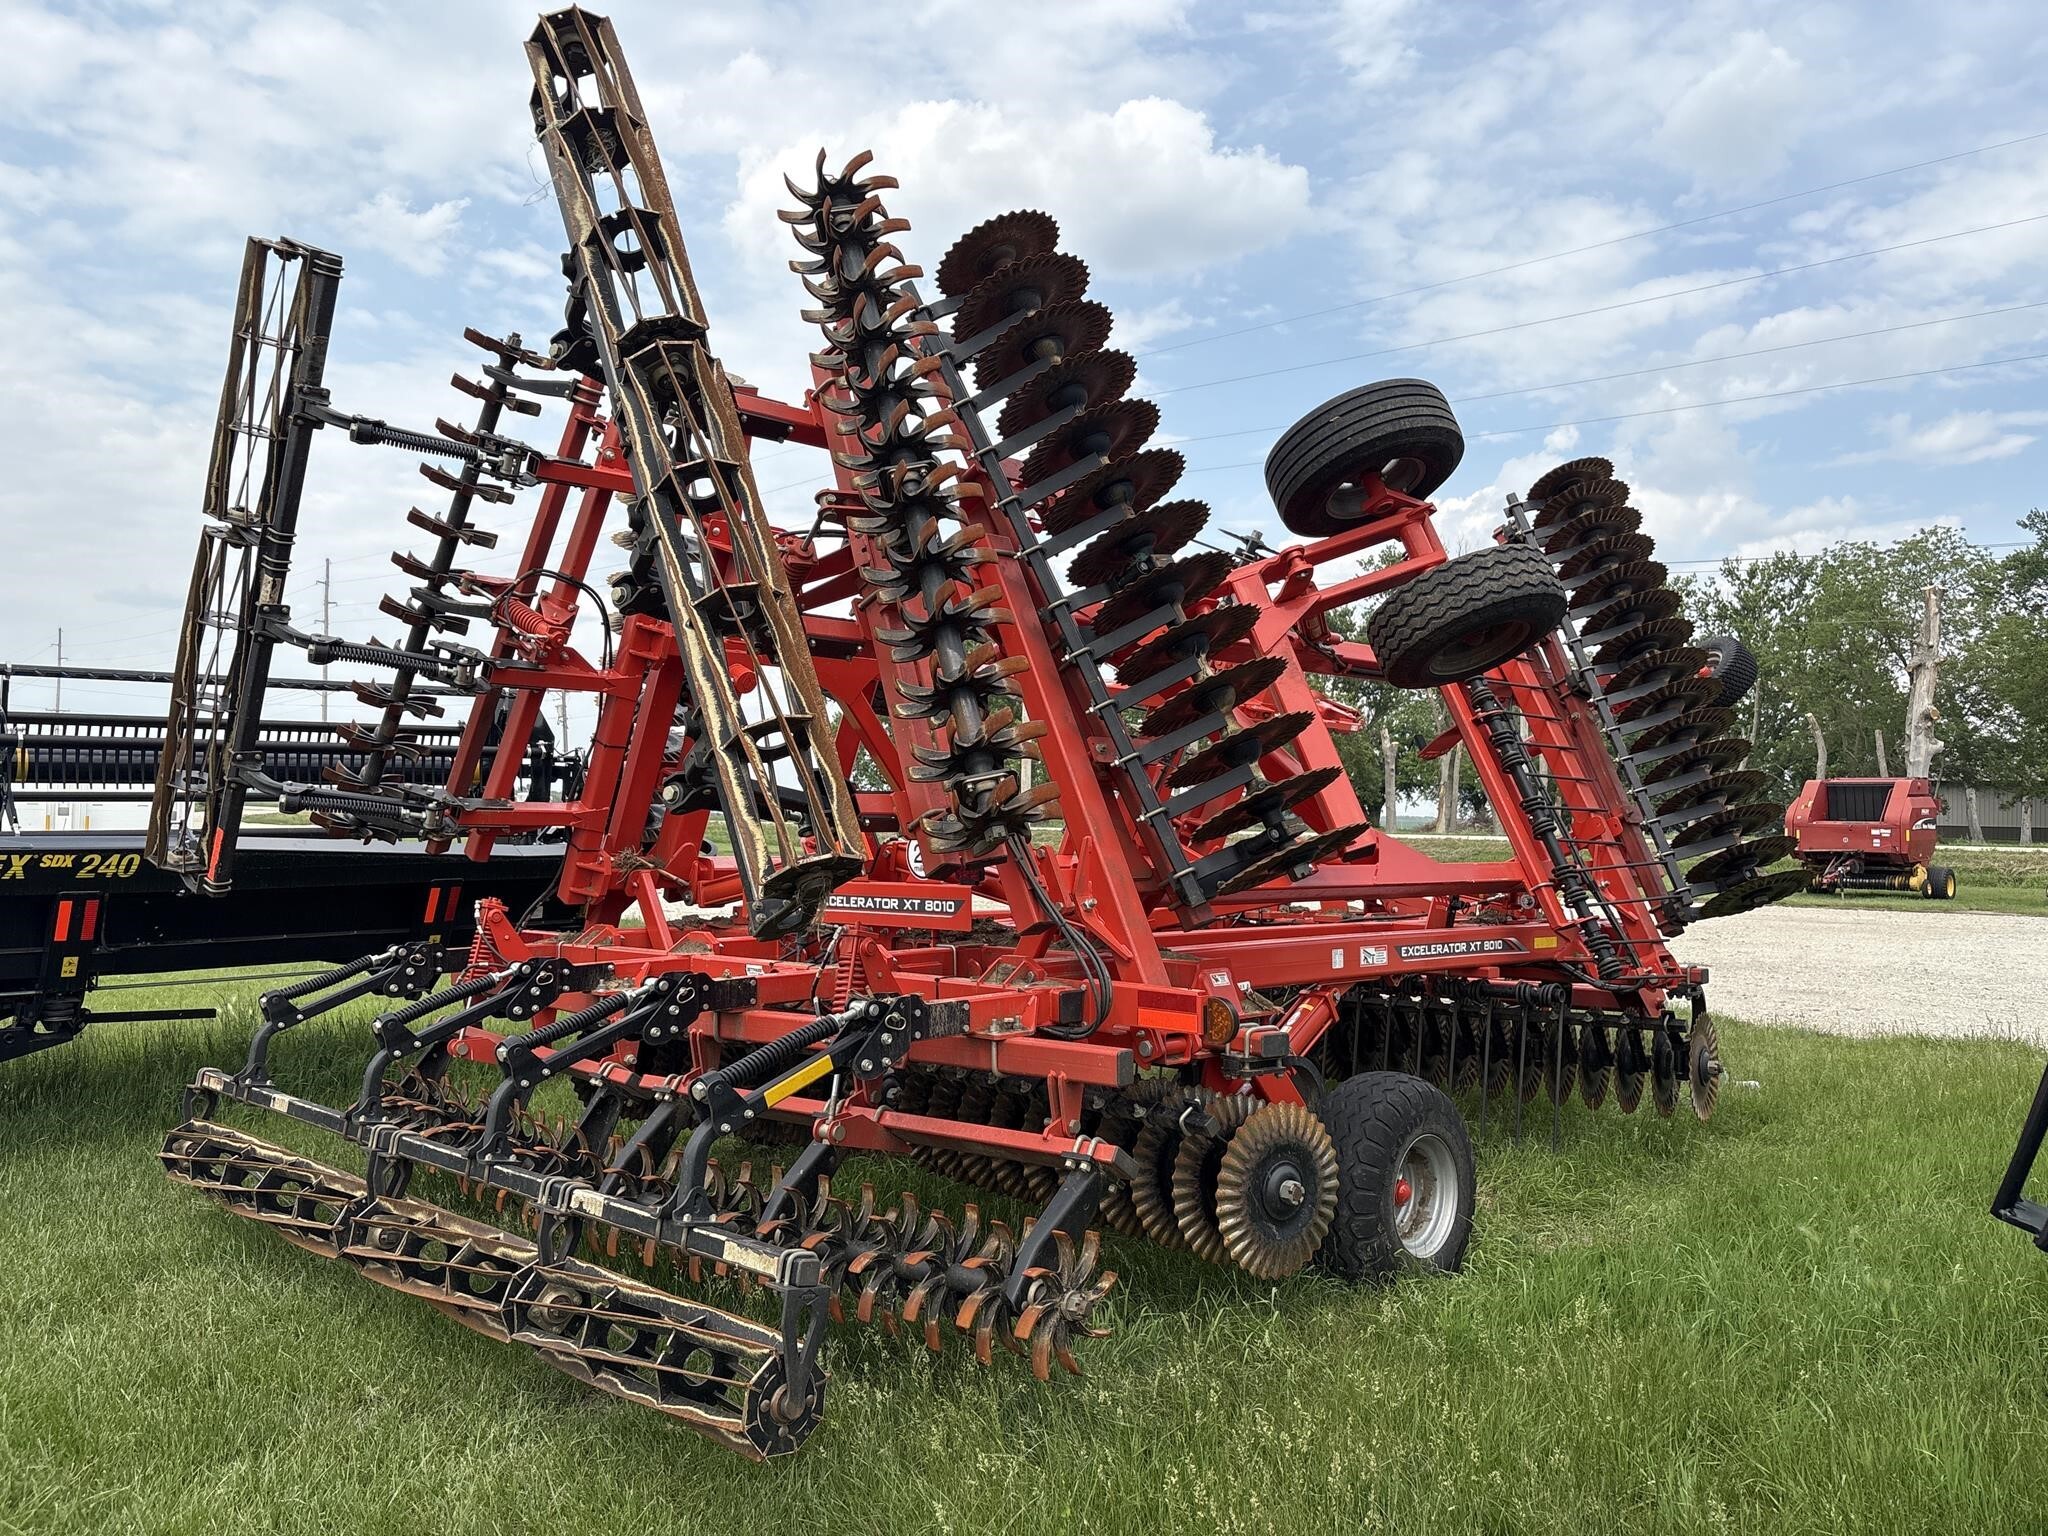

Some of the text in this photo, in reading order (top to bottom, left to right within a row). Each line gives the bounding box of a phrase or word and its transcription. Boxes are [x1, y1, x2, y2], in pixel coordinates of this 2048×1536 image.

[39, 854, 78, 868] SDX
[75, 853, 141, 878] 240
[827, 896, 955, 912] CELERATOR XT 8010
[1402, 940, 1503, 957] EXCELERATOR XT 8010
